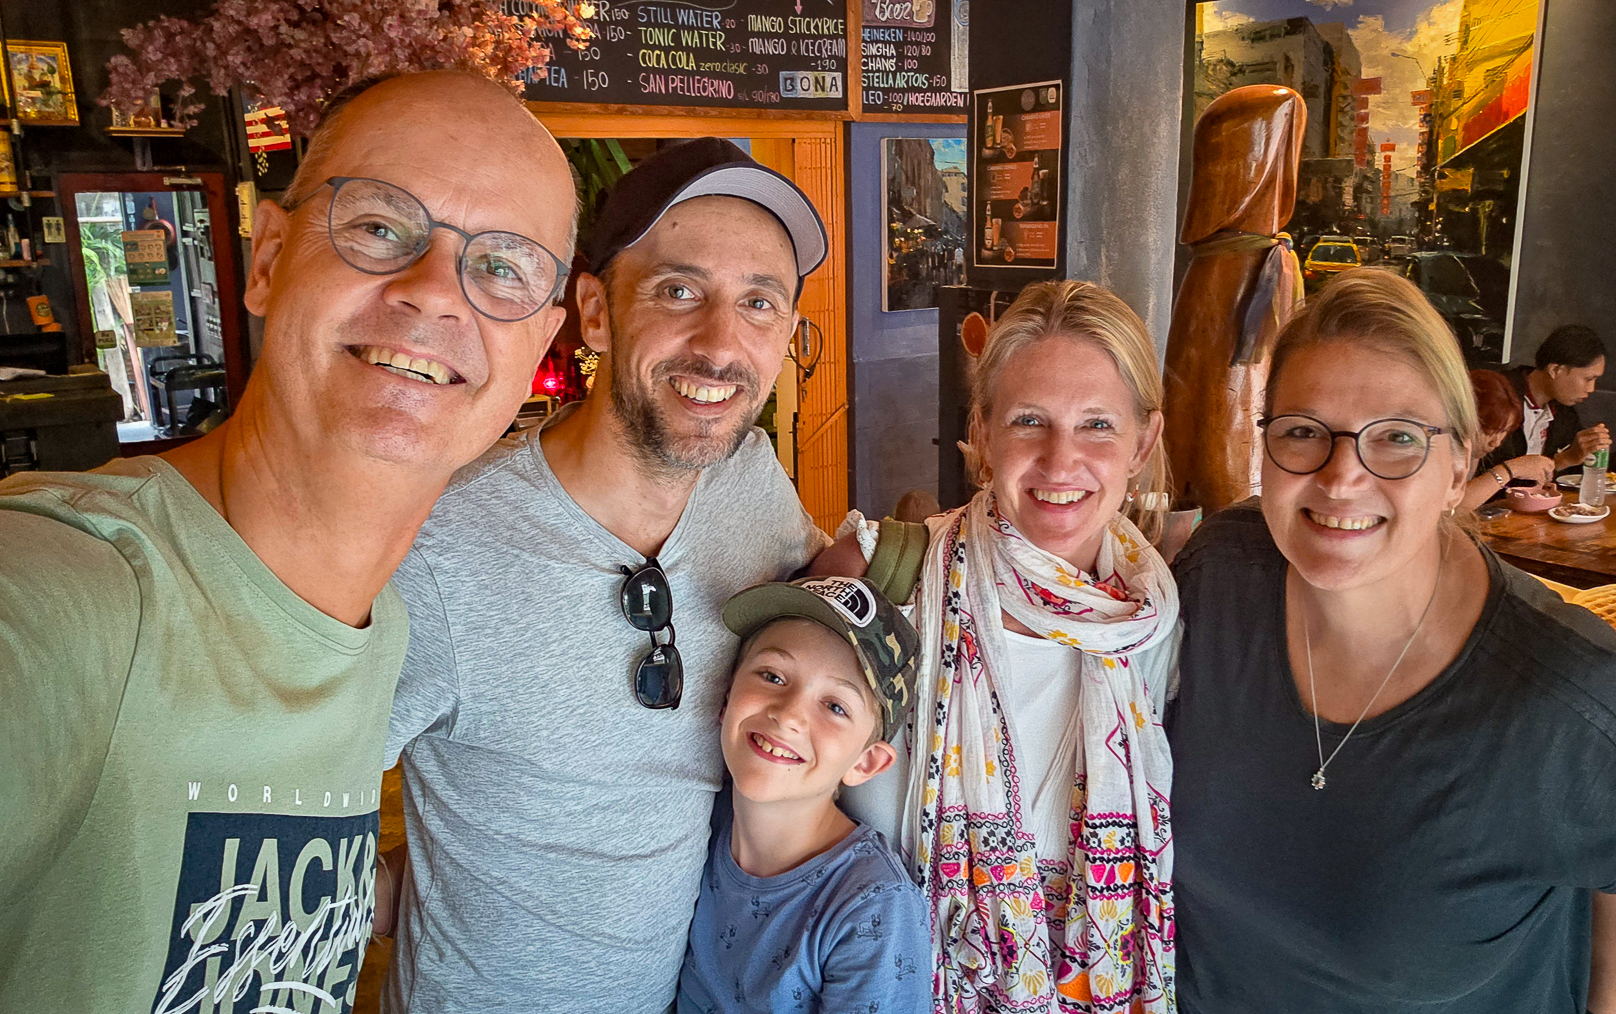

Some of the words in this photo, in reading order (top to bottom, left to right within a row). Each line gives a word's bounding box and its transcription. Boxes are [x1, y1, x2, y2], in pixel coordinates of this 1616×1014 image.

[637, 6, 674, 24] STILL
[676, 8, 722, 29] WATER
[748, 14, 784, 33] MANGO
[637, 27, 677, 47] TONIC
[680, 29, 726, 51] WATER
[861, 28, 903, 42] HEINEKEN
[748, 37, 787, 55] MANGO
[861, 43, 896, 56] SINGHA
[639, 49, 668, 69] COCA
[669, 51, 697, 71] COLA
[861, 57, 896, 71] CHANG
[904, 58, 918, 70] 100
[539, 65, 568, 88] TEA
[583, 69, 609, 91] 150
[639, 72, 666, 94] SAN
[668, 75, 735, 99] PELLEGRINO
[783, 75, 839, 93] BONA
[861, 72, 894, 88] STELLA
[895, 71, 930, 89] ARTOIS
[863, 90, 884, 105] LEO
[908, 92, 965, 108] HOEGAARDEN
[806, 584, 852, 597] NORTH
[831, 580, 858, 592] THE
